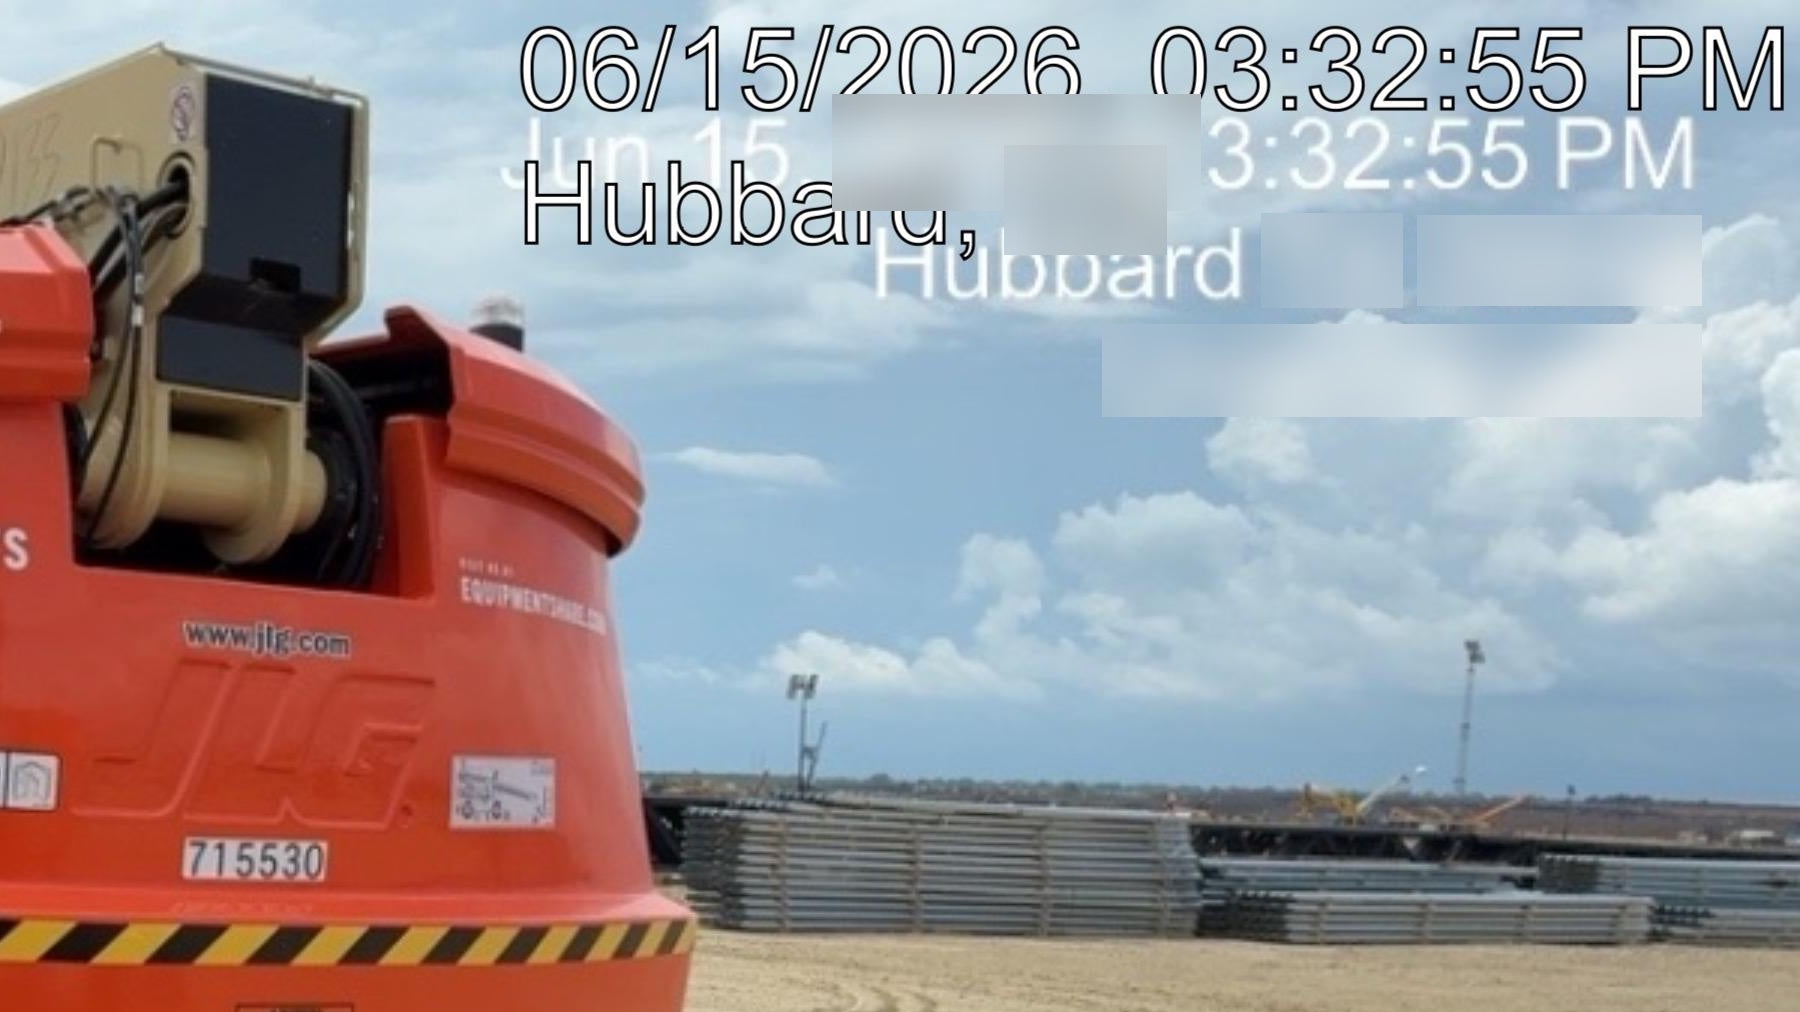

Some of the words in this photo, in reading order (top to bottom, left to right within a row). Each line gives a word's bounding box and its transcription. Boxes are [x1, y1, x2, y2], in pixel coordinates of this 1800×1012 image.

[184, 621, 350, 657] www.jlg.com
[71, 658, 437, 831] JLG
[189, 840, 325, 878] 715530
